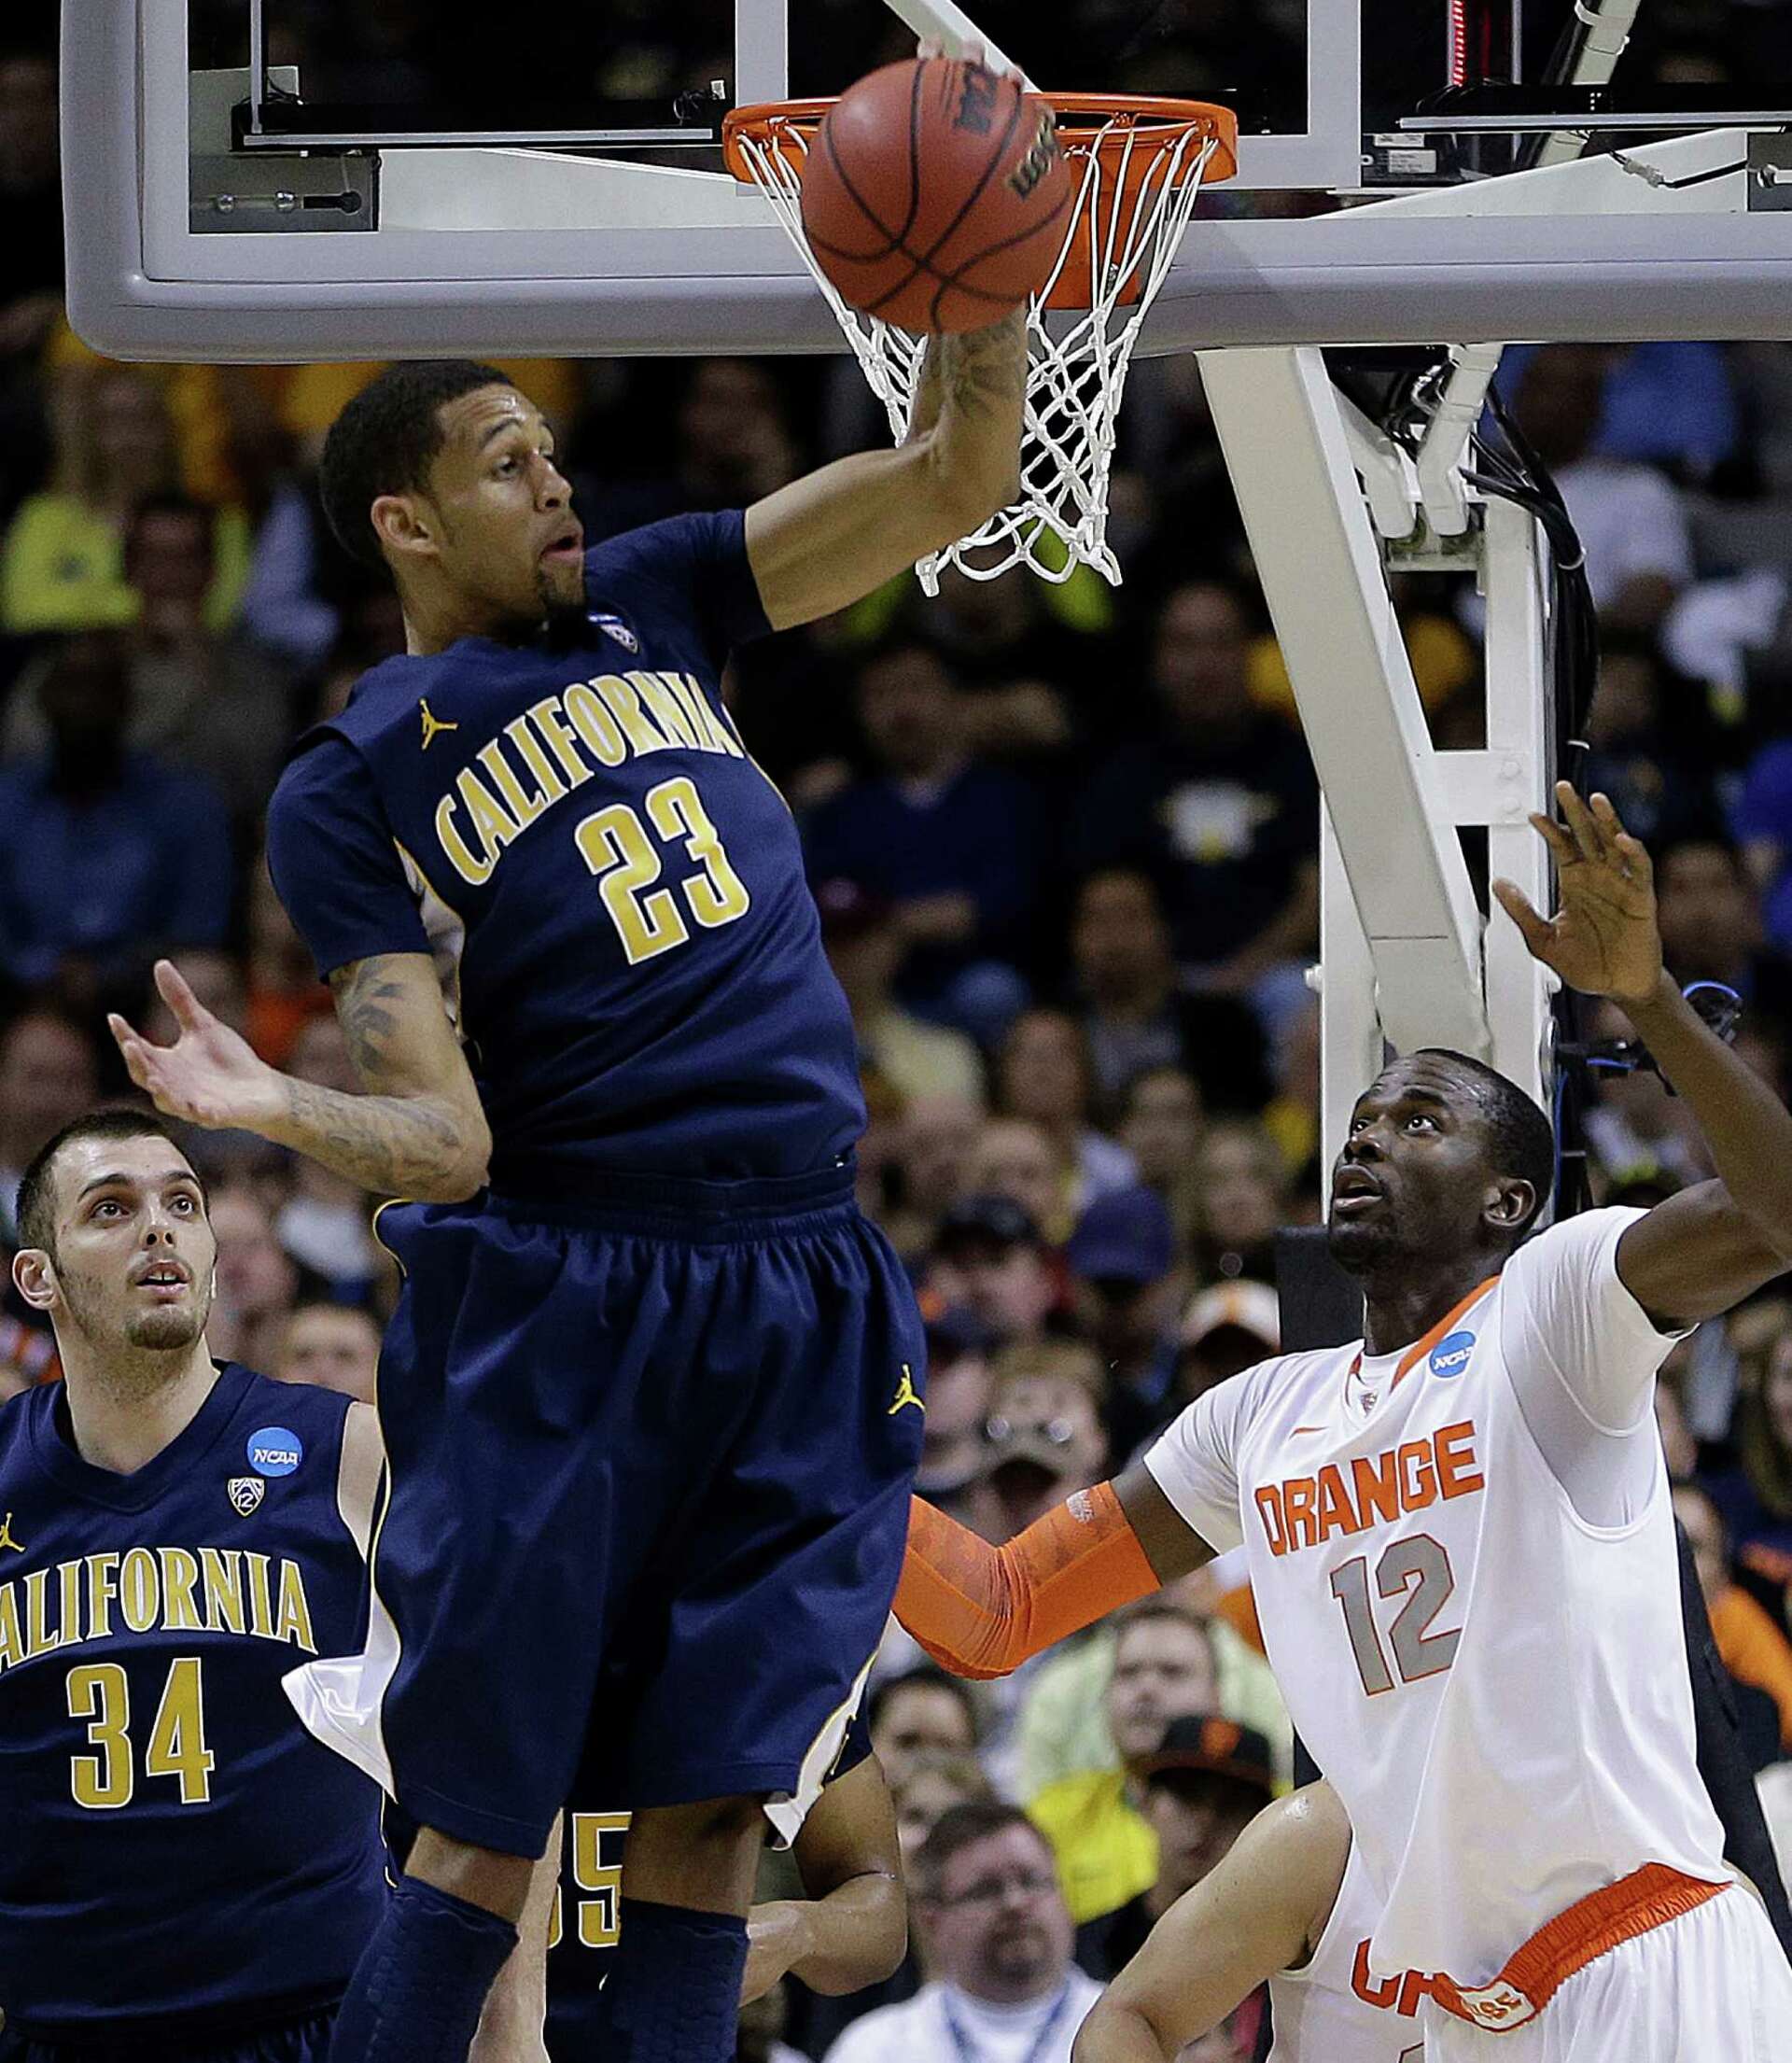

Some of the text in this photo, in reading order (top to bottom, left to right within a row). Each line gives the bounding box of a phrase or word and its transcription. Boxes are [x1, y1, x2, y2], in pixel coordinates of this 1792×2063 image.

[436, 670, 745, 886] CALIFORNIA
[574, 776, 750, 965] 23
[237, 1493, 254, 1509] 12
[253, 1448, 299, 1465] NCAA
[1254, 1420, 1485, 1557] ORANGE
[1329, 1532, 1463, 1697] 12
[65, 1657, 215, 1808] 34
[547, 1811, 633, 1949] 5
